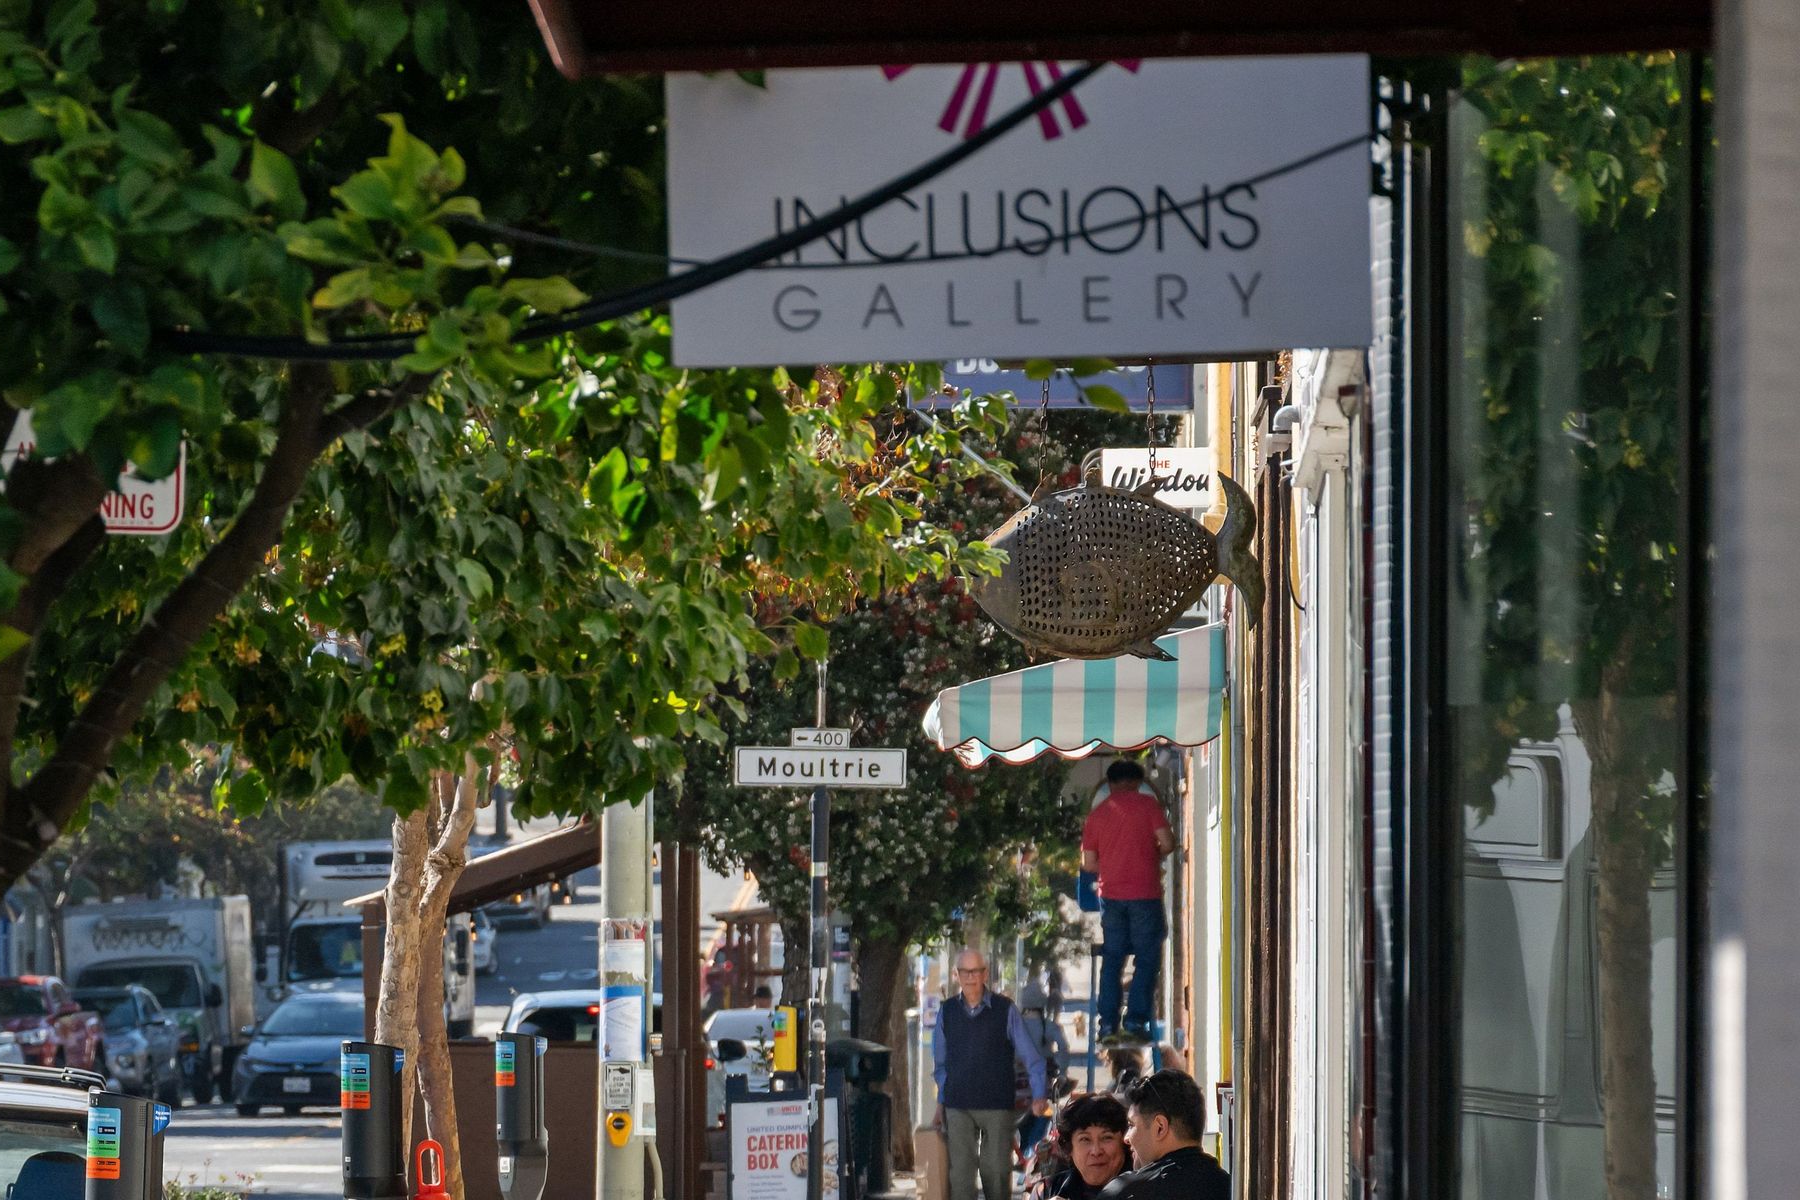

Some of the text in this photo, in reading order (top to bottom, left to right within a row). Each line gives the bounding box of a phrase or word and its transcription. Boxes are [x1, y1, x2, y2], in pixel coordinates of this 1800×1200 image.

[774, 182, 1260, 265] INCLUSIONS
[772, 271, 1262, 332] GALLERY
[813, 732, 844, 746] 400
[758, 756, 882, 778] Moultrie
[747, 1133, 808, 1152] CATERIN
[747, 1152, 779, 1170] BOX
